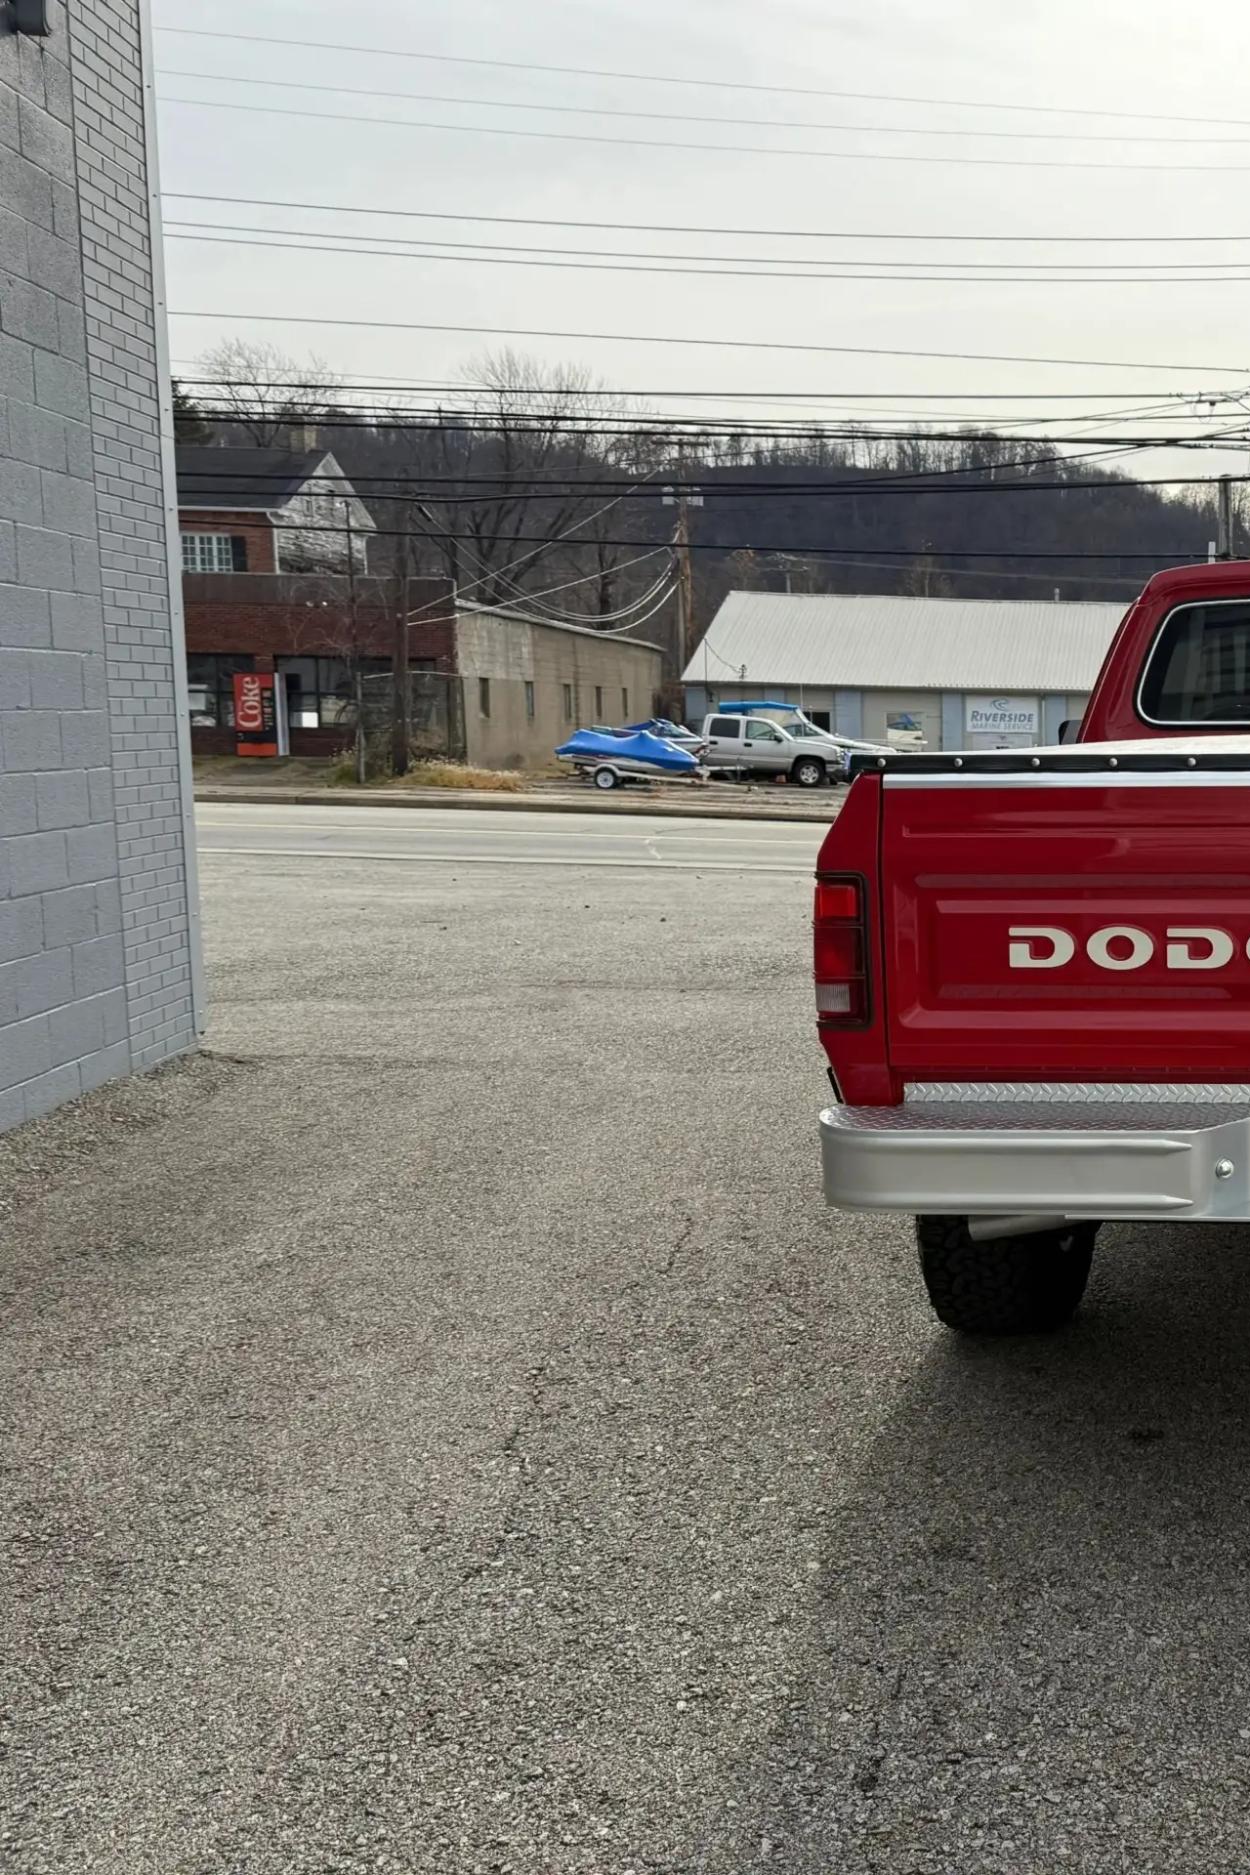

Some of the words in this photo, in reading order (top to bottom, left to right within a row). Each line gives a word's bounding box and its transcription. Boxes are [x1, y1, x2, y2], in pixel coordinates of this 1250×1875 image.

[237, 676, 262, 728] Coke
[970, 710, 1034, 723] RIVERSIDE
[1004, 722, 1033, 731] SERVICE
